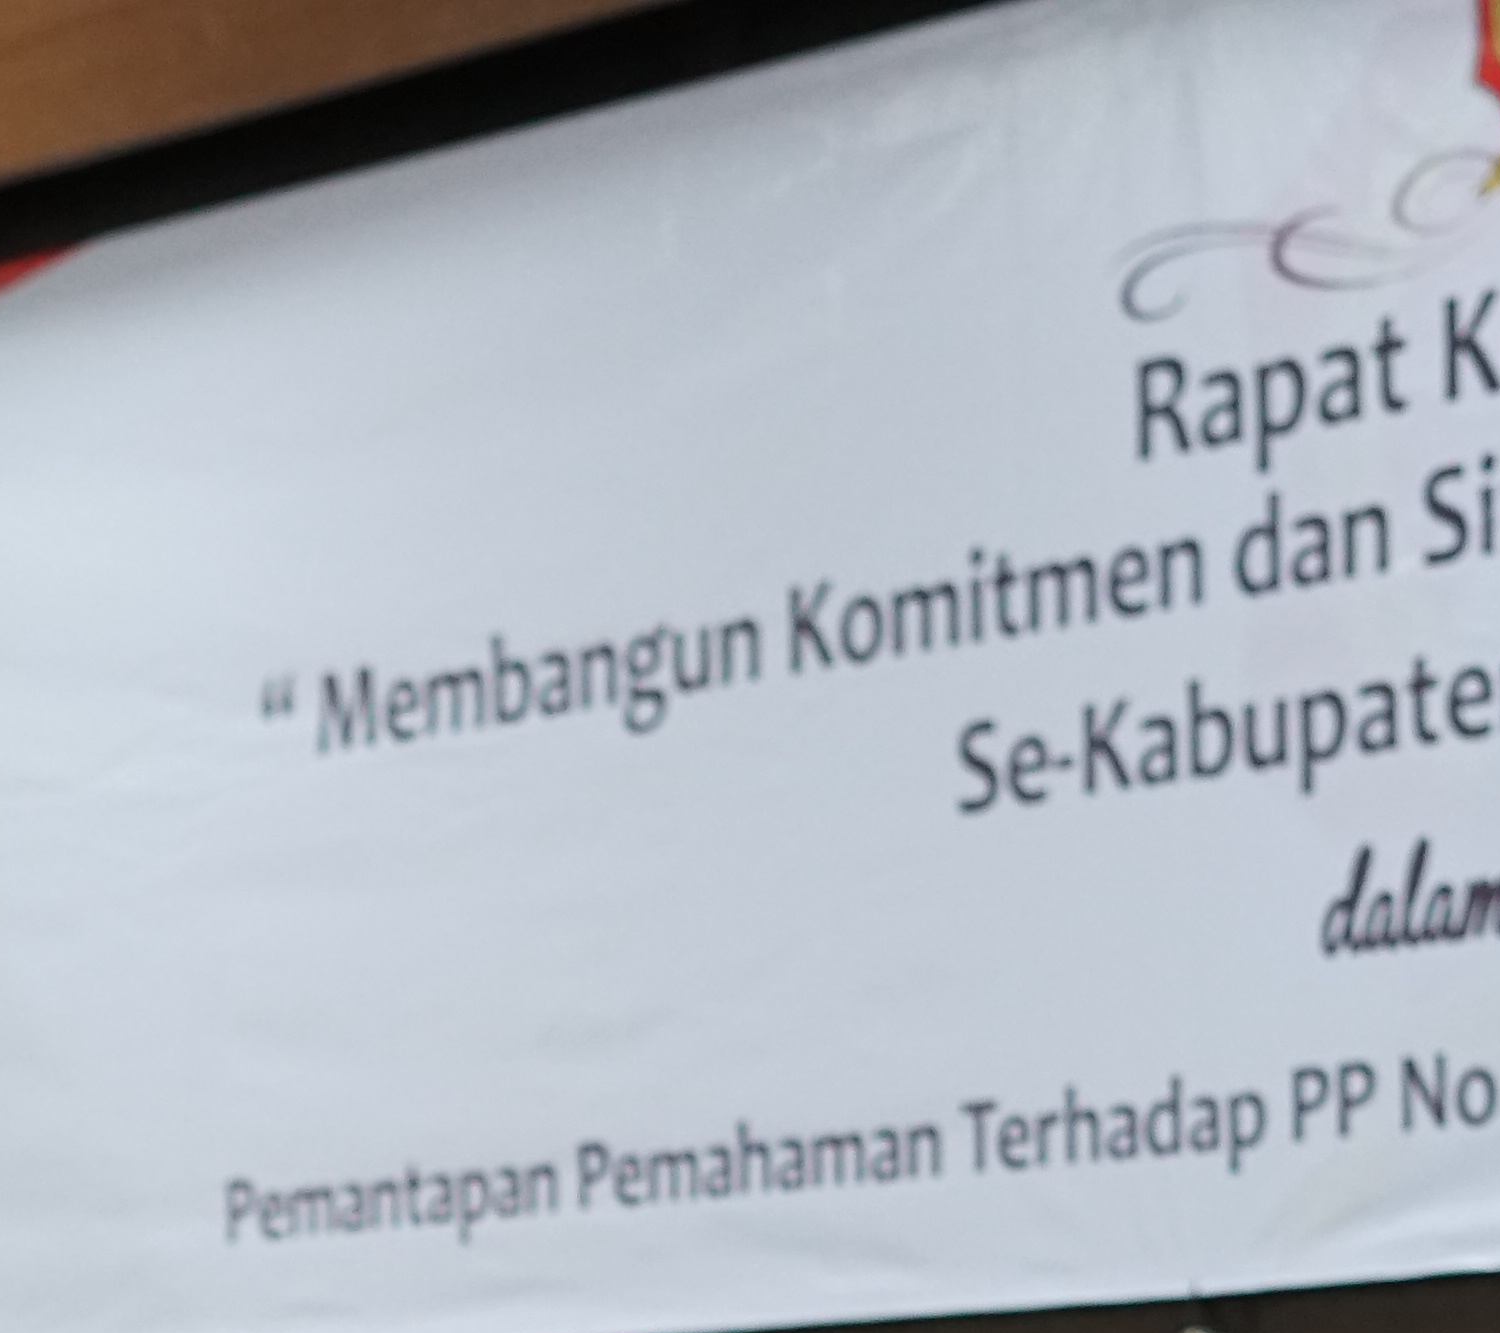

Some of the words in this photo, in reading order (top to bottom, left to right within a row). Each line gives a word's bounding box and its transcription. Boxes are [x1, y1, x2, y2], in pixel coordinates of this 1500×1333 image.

[1138, 318, 1408, 475] Rapat
[322, 618, 760, 752] Membangun
[789, 549, 1204, 672] Komitmen
[1234, 493, 1390, 597] dan
[226, 1162, 558, 1246] Pemantapan
[577, 1124, 941, 1207] Pemahaman
[962, 1077, 1266, 1172] Terhadap
[1292, 1061, 1377, 1140] PP
